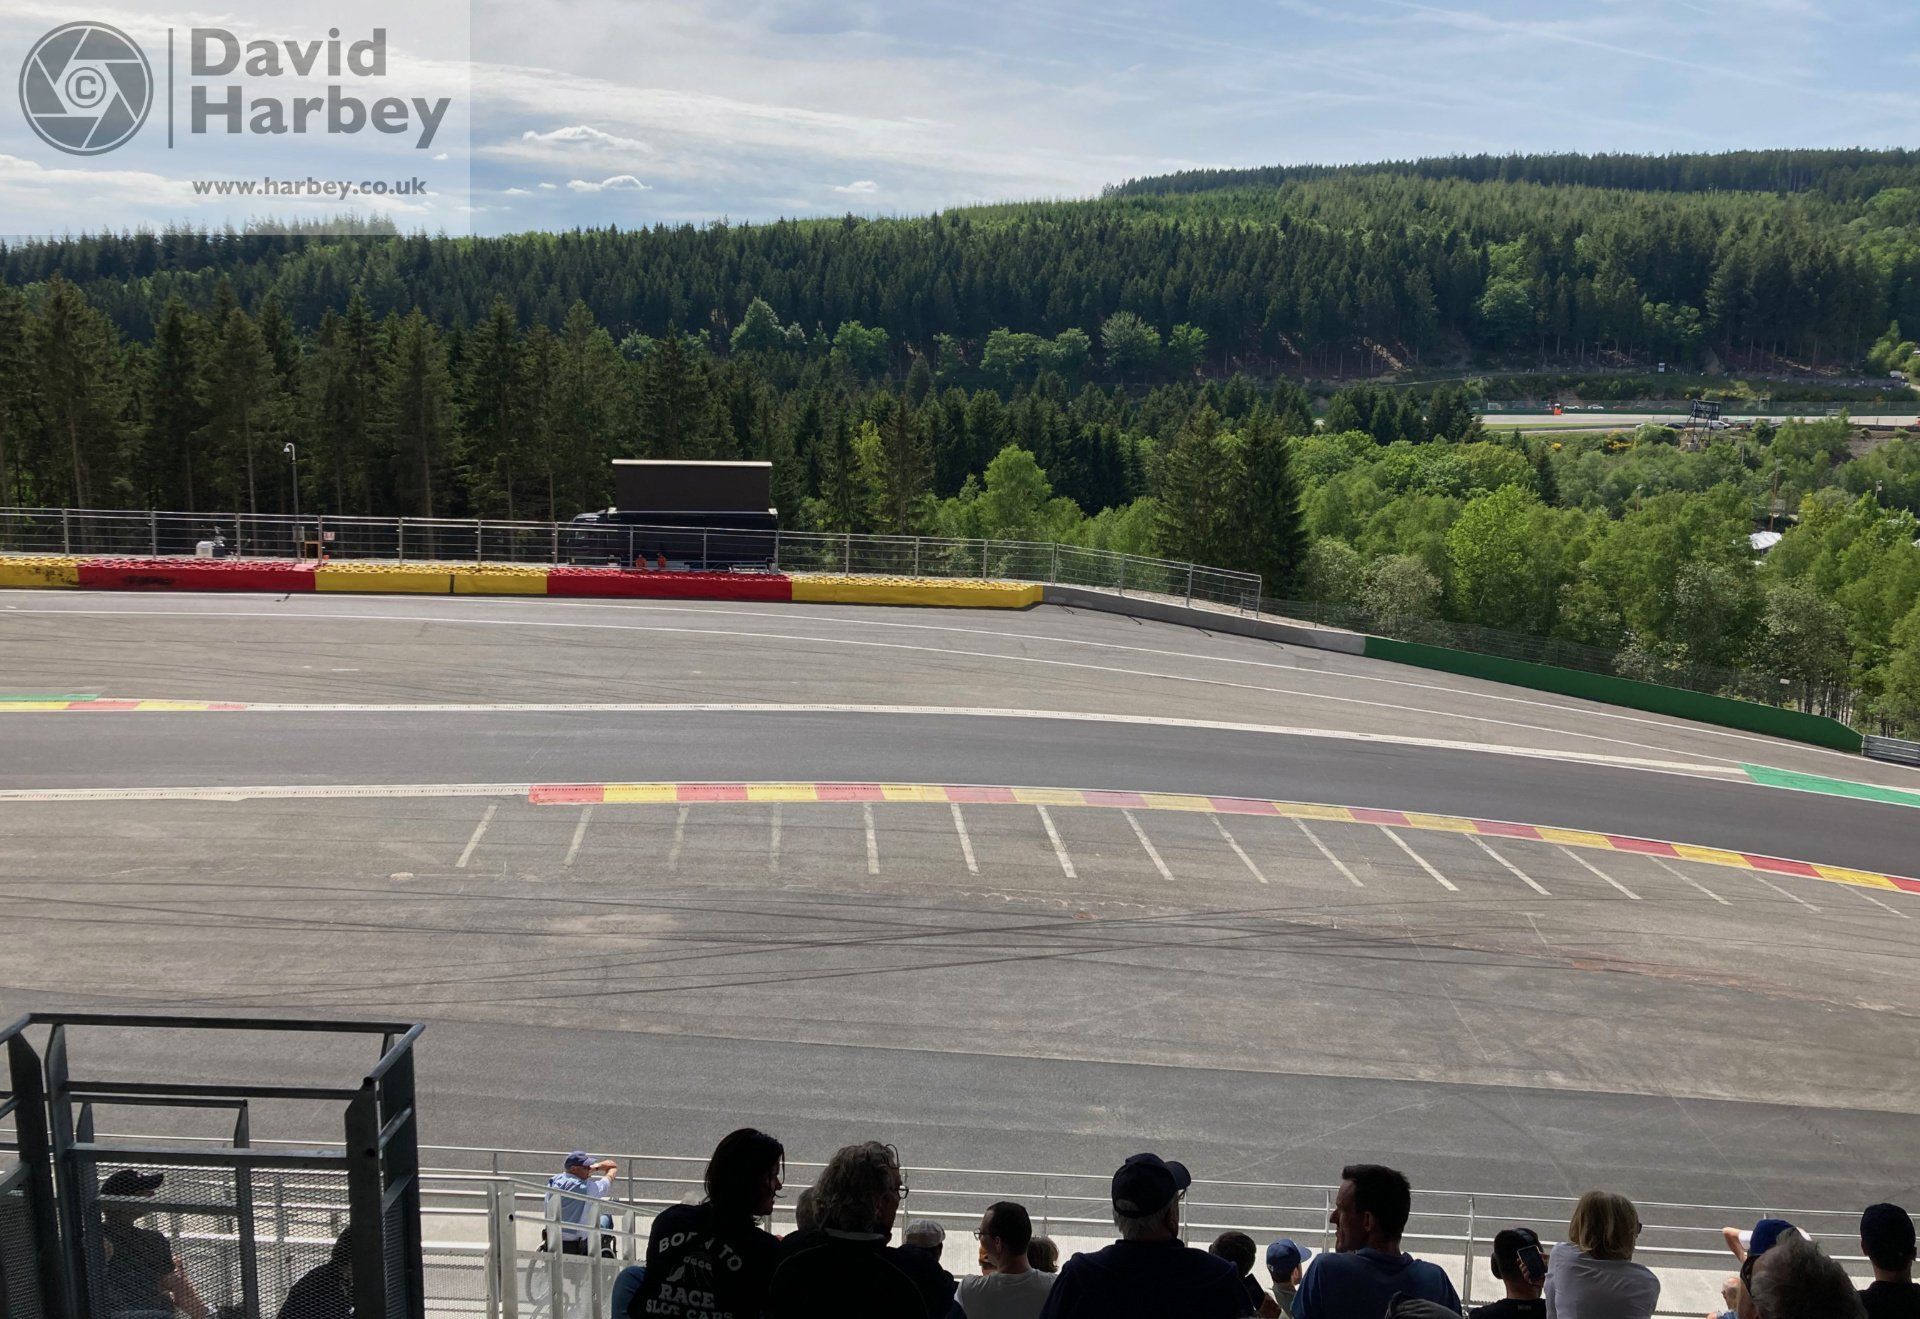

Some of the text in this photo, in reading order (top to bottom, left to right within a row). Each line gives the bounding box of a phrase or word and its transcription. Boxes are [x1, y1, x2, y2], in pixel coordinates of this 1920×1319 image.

[718, 1243, 743, 1272] TO
[645, 1299, 680, 1316] SLOT
[658, 1283, 715, 1309] RACE
